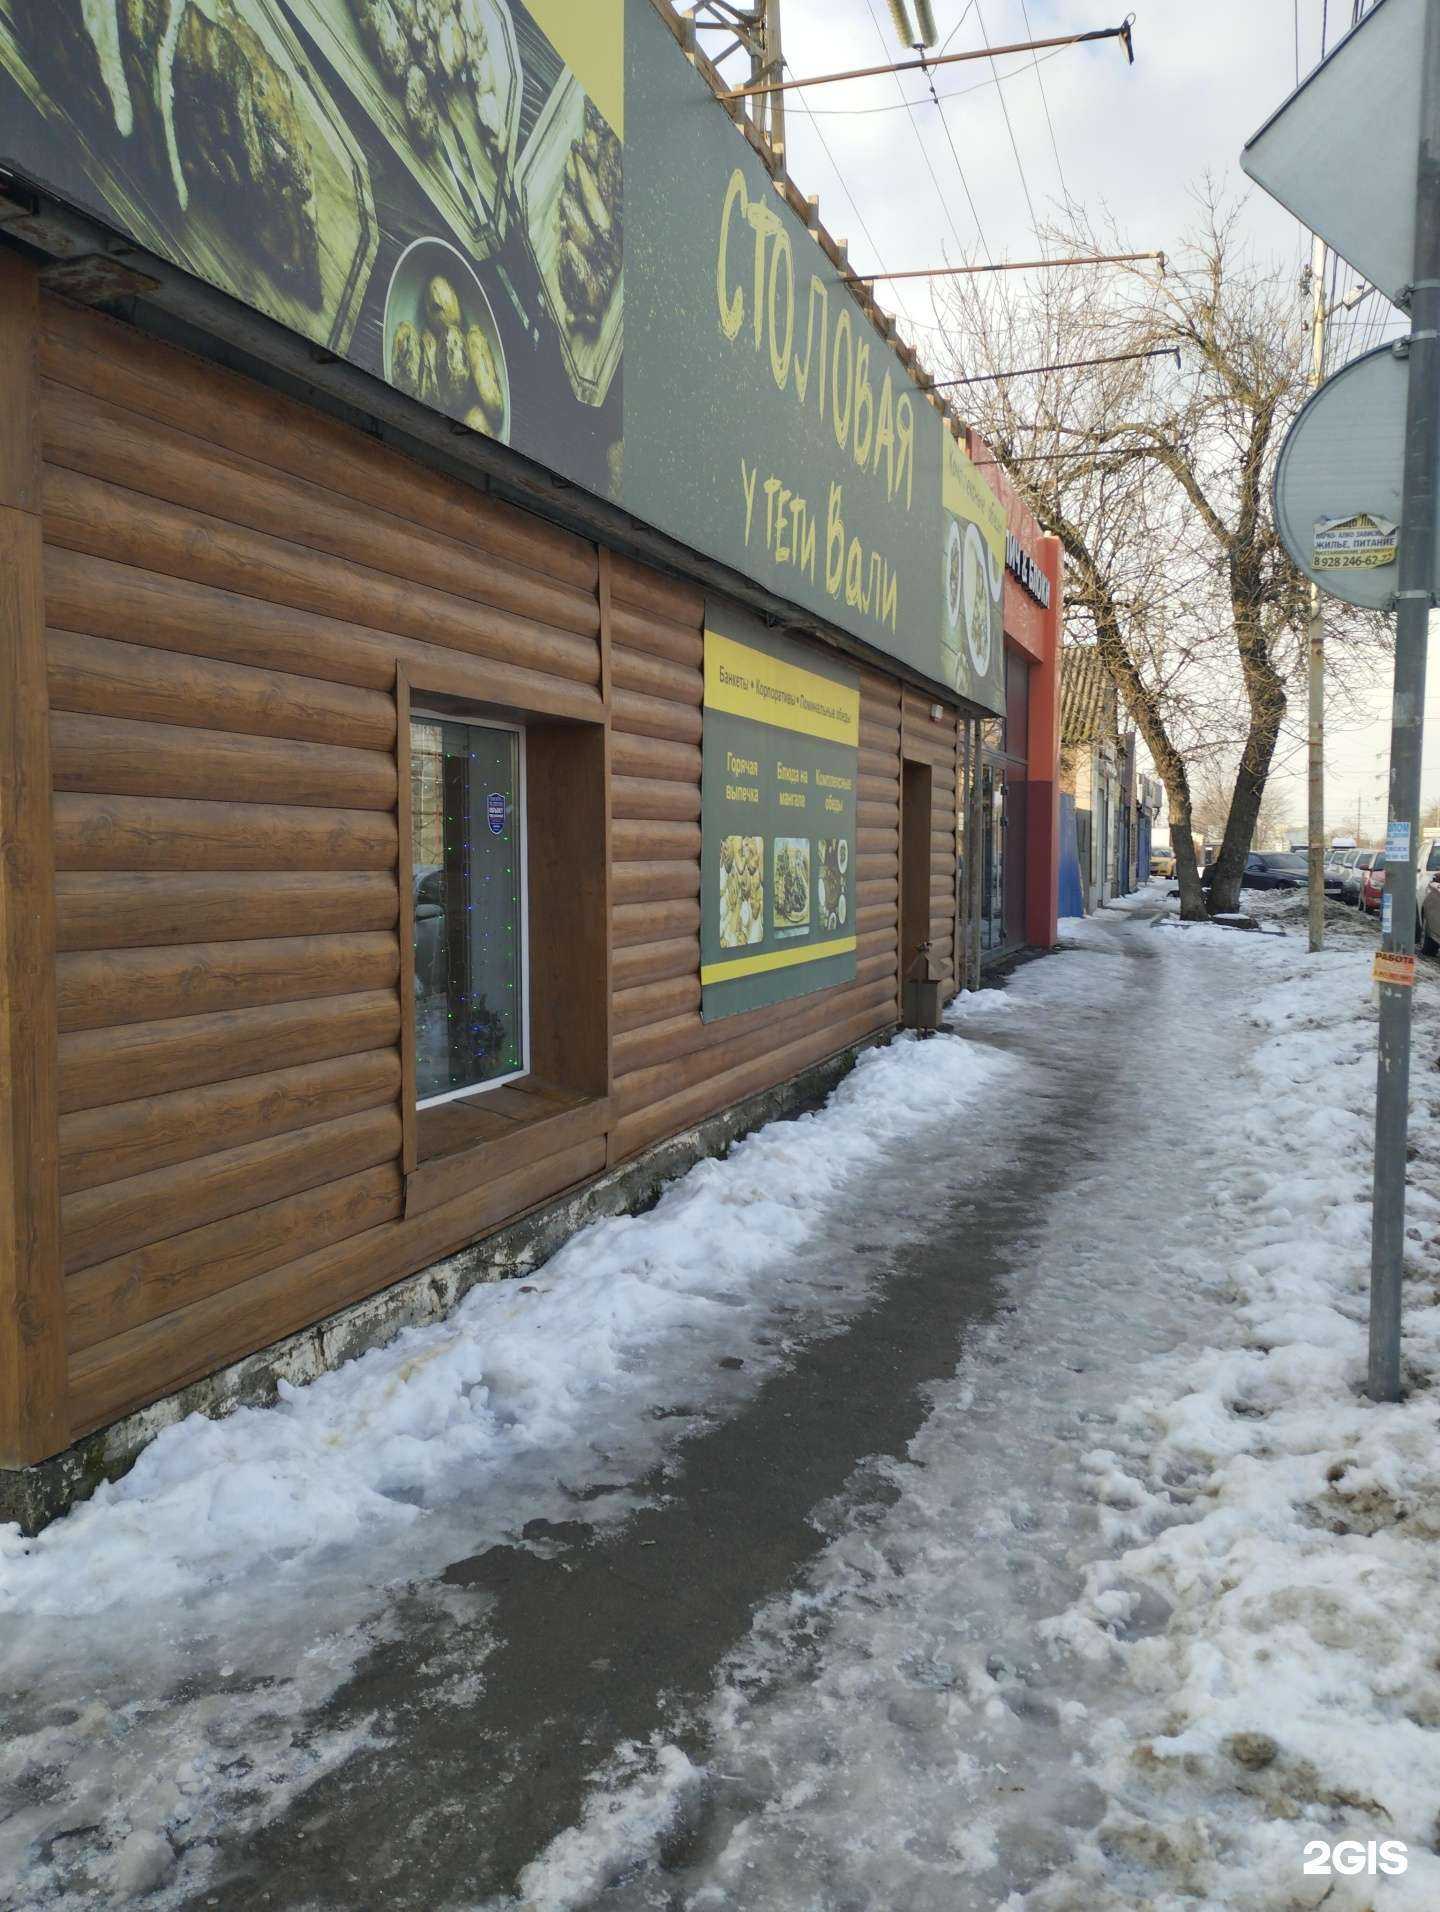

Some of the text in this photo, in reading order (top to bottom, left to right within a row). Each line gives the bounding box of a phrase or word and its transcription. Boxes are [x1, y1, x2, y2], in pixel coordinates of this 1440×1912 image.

[716, 167, 915, 512] СТОЛОВАЯ
[1354, 537, 1396, 548] ПИТАНИЕ
[1313, 556, 1320, 566] 8
[1321, 557, 1341, 567] 928
[720, 665, 749, 690] Банкеты
[755, 679, 796, 706] Корпоративы
[727, 752, 758, 777] Горячая
